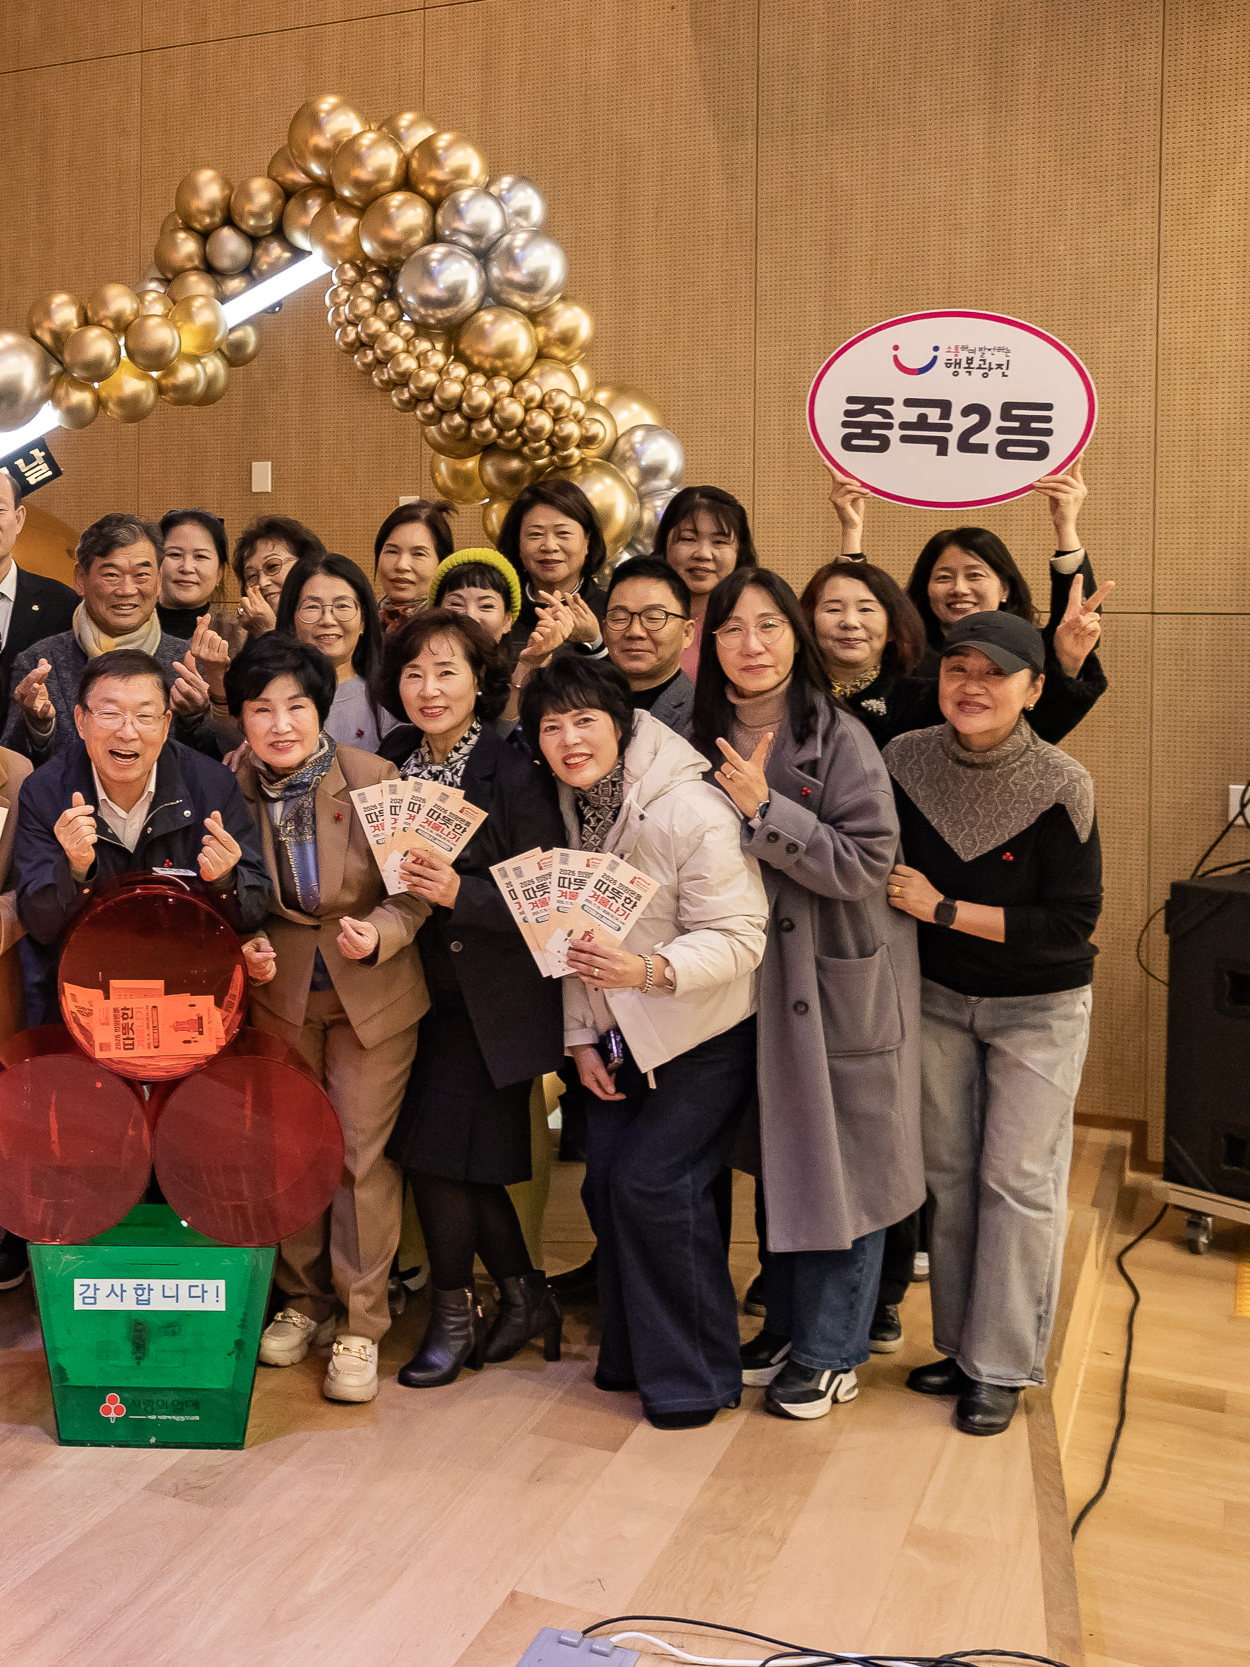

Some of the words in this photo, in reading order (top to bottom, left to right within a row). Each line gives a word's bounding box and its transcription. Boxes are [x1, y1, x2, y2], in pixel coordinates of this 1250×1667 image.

[944, 356, 1010, 378] 행복광진
[840, 395, 1054, 462] 중곡2동
[13, 448, 53, 485] 날
[426, 808, 467, 836] 따뜻한
[522, 881, 552, 900] 따뜻
[557, 876, 588, 891] 따뜻
[557, 890, 579, 901] 겨울
[593, 879, 638, 912] 따뜻한
[528, 897, 551, 910] 겨울
[588, 890, 630, 921] 겨울나기
[121, 1006, 135, 1051] 따뜻한
[79, 1282, 220, 1306] 감사합니다!
